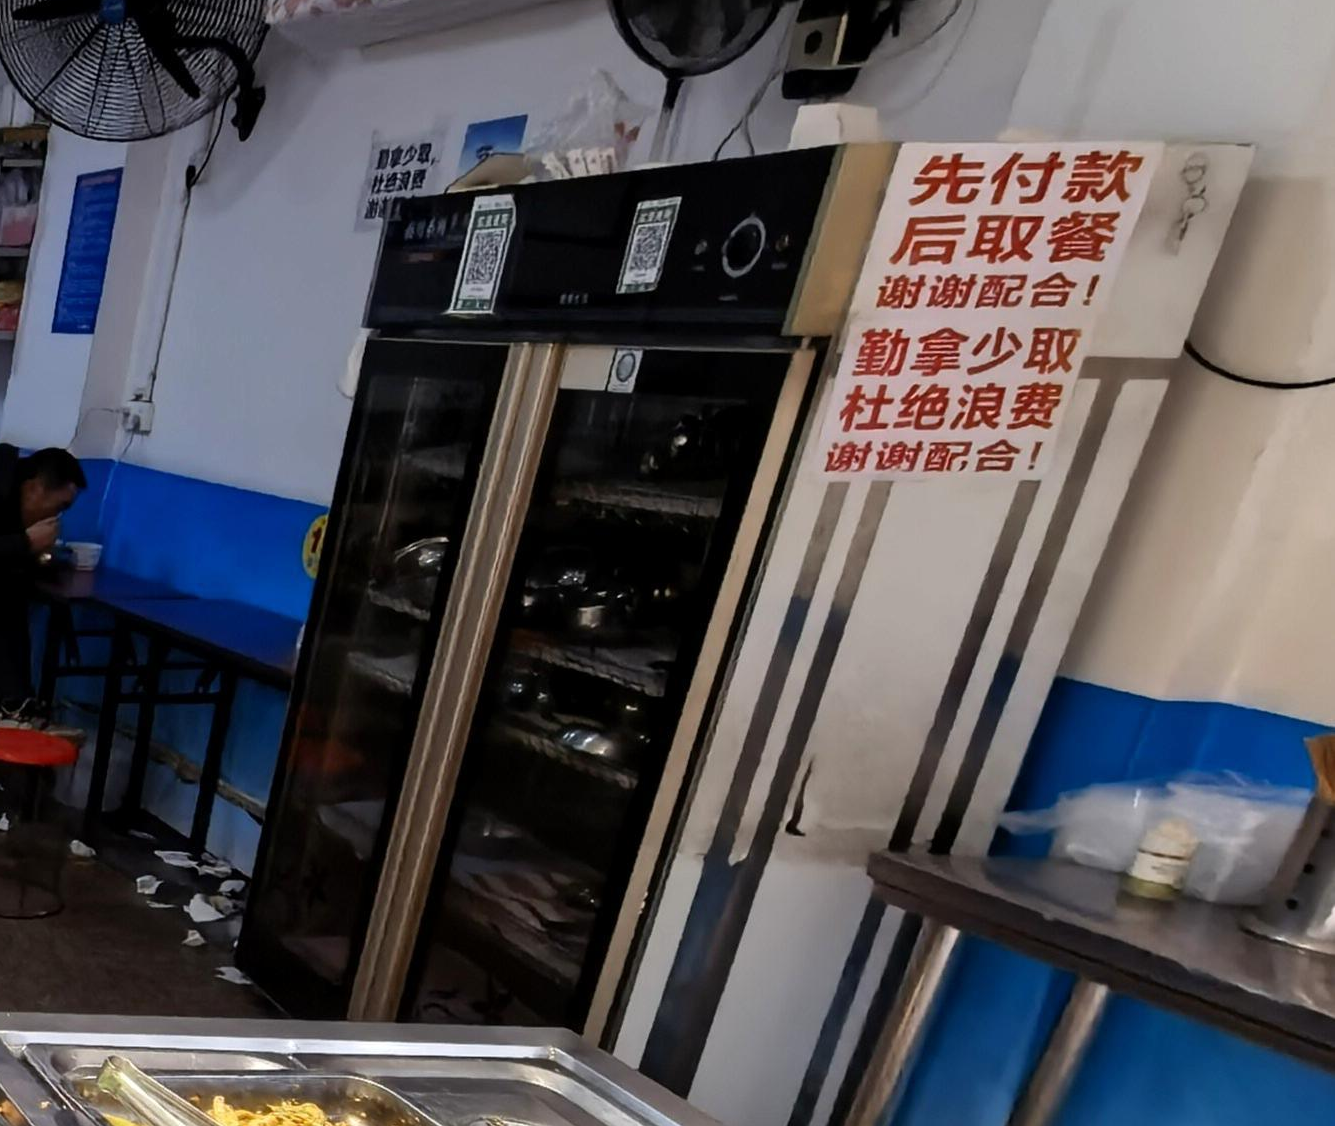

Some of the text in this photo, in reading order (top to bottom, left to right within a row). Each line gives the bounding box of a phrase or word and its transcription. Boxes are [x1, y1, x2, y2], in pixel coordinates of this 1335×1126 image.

[907, 150, 1145, 206] 先付款
[888, 211, 1121, 266] 后取餐
[875, 271, 1101, 309] 谢谢配合！
[851, 326, 1083, 377] 勤拿少取
[839, 382, 1064, 433] 杜绝浪费
[823, 438, 1044, 473] 谢谢配合！
